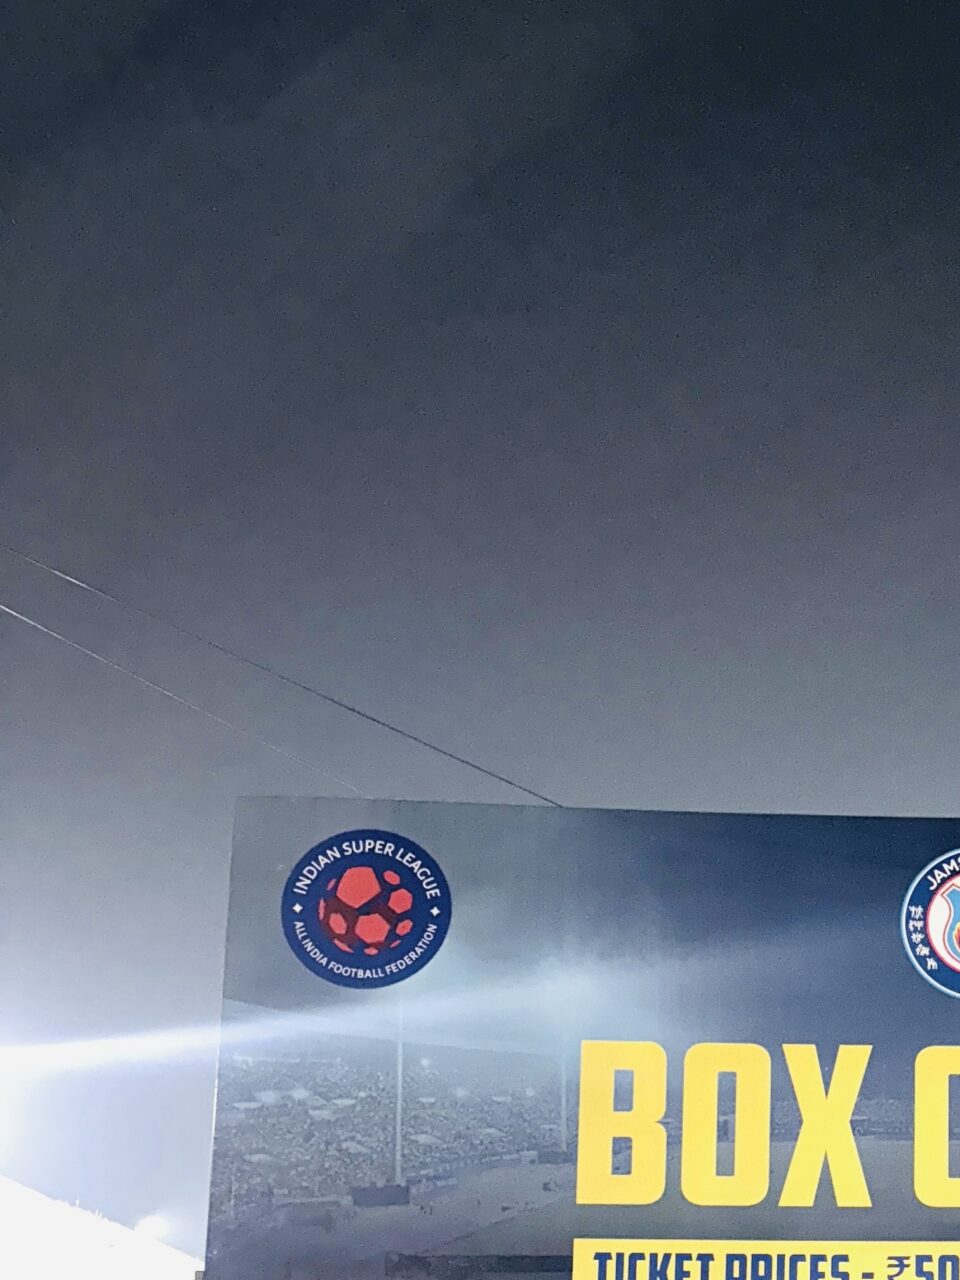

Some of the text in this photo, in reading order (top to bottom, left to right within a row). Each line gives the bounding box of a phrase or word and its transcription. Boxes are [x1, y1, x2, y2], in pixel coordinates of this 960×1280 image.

[293, 839, 441, 899] INDIAN SUPER LEAGUE
[294, 920, 438, 979] ALL INDIA FOOTBALL FEDERATION
[576, 1040, 874, 1207] BOX
